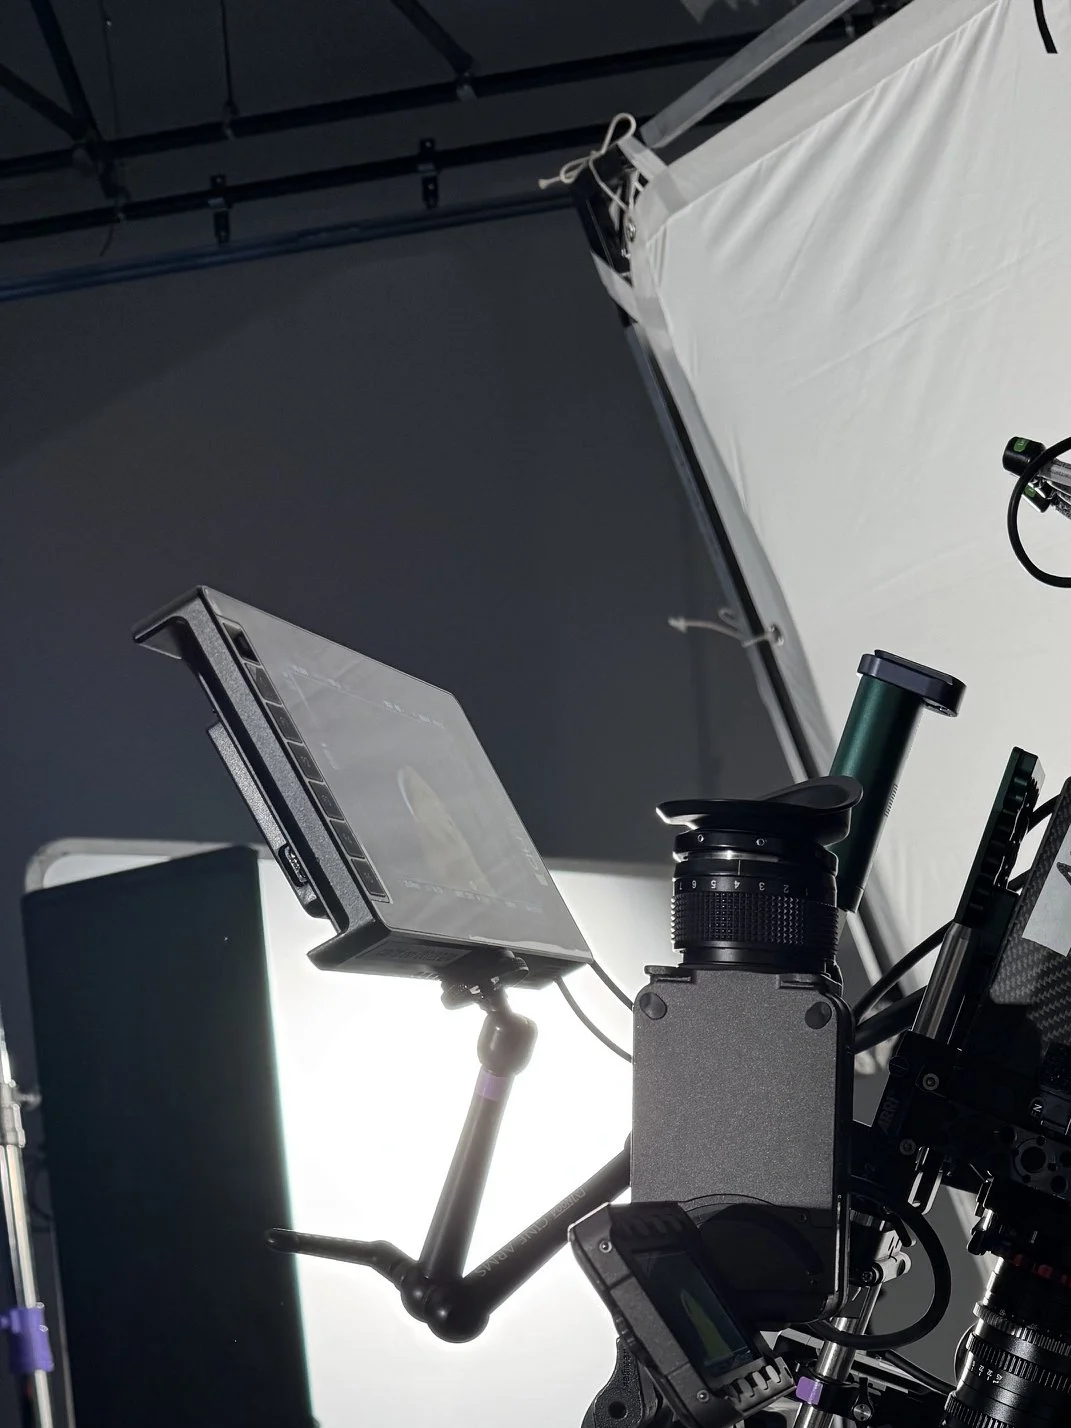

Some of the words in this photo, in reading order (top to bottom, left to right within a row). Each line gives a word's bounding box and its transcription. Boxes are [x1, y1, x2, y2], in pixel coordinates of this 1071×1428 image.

[692, 880, 696, 888] 6
[711, 880, 716, 888] 5
[734, 880, 740, 889] 4
[758, 882, 765, 890] 3
[783, 884, 789, 893] 2
[474, 1242, 516, 1278] ARMS
